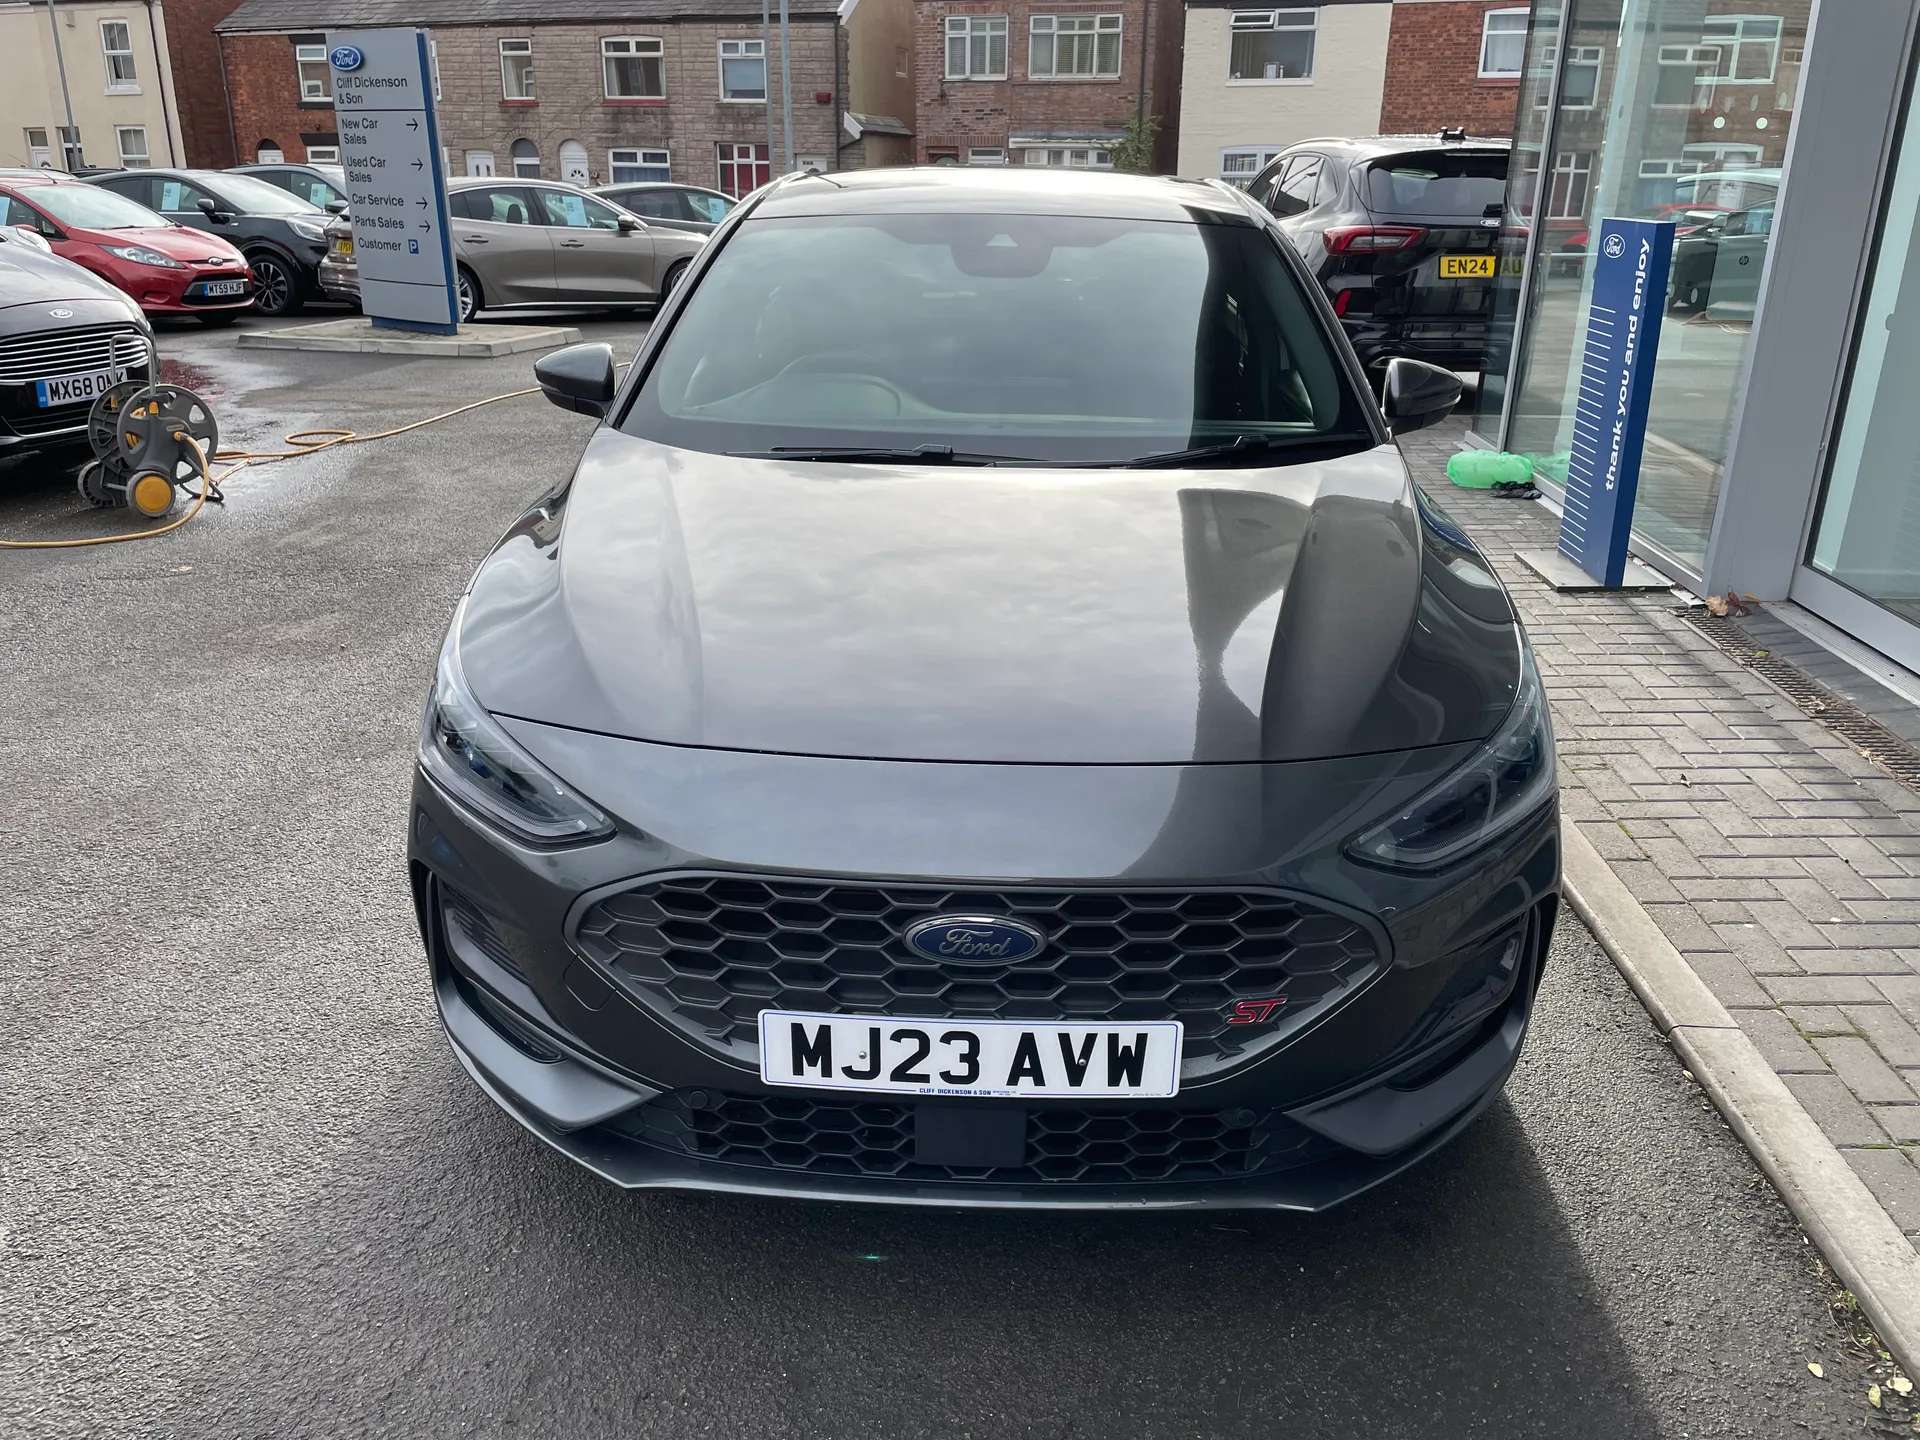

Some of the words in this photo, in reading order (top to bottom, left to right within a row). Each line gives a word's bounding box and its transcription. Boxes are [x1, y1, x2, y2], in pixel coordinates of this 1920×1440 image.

[335, 49, 354, 66] Ford
[336, 76, 353, 89] Cliff
[354, 76, 408, 88] Dickenson
[338, 93, 345, 105] &
[346, 92, 364, 104] Son
[341, 118, 360, 129] New
[362, 117, 378, 129] Car
[343, 132, 367, 145] Sales
[346, 156, 368, 168] Used
[369, 156, 386, 168] Car
[348, 170, 373, 183] Sales
[352, 193, 366, 205] Car
[367, 193, 405, 207] Service
[354, 215, 377, 228] Parts
[377, 216, 405, 229] Sales
[358, 237, 402, 251] Customer
[1606, 236, 1622, 254] Ford
[1447, 259, 1489, 274] EN24
[1502, 258, 1525, 274] AU
[208, 282, 228, 295] MT59
[1606, 420, 1623, 491] thank
[1617, 369, 1630, 416] you
[1624, 315, 1638, 366] and
[1632, 237, 1650, 310] enjoy
[49, 378, 93, 401] MX68
[938, 928, 1012, 956] Ford
[1226, 997, 1288, 1025] ST
[789, 1022, 981, 1085] MJ23
[1005, 1031, 1149, 1087] AVW
